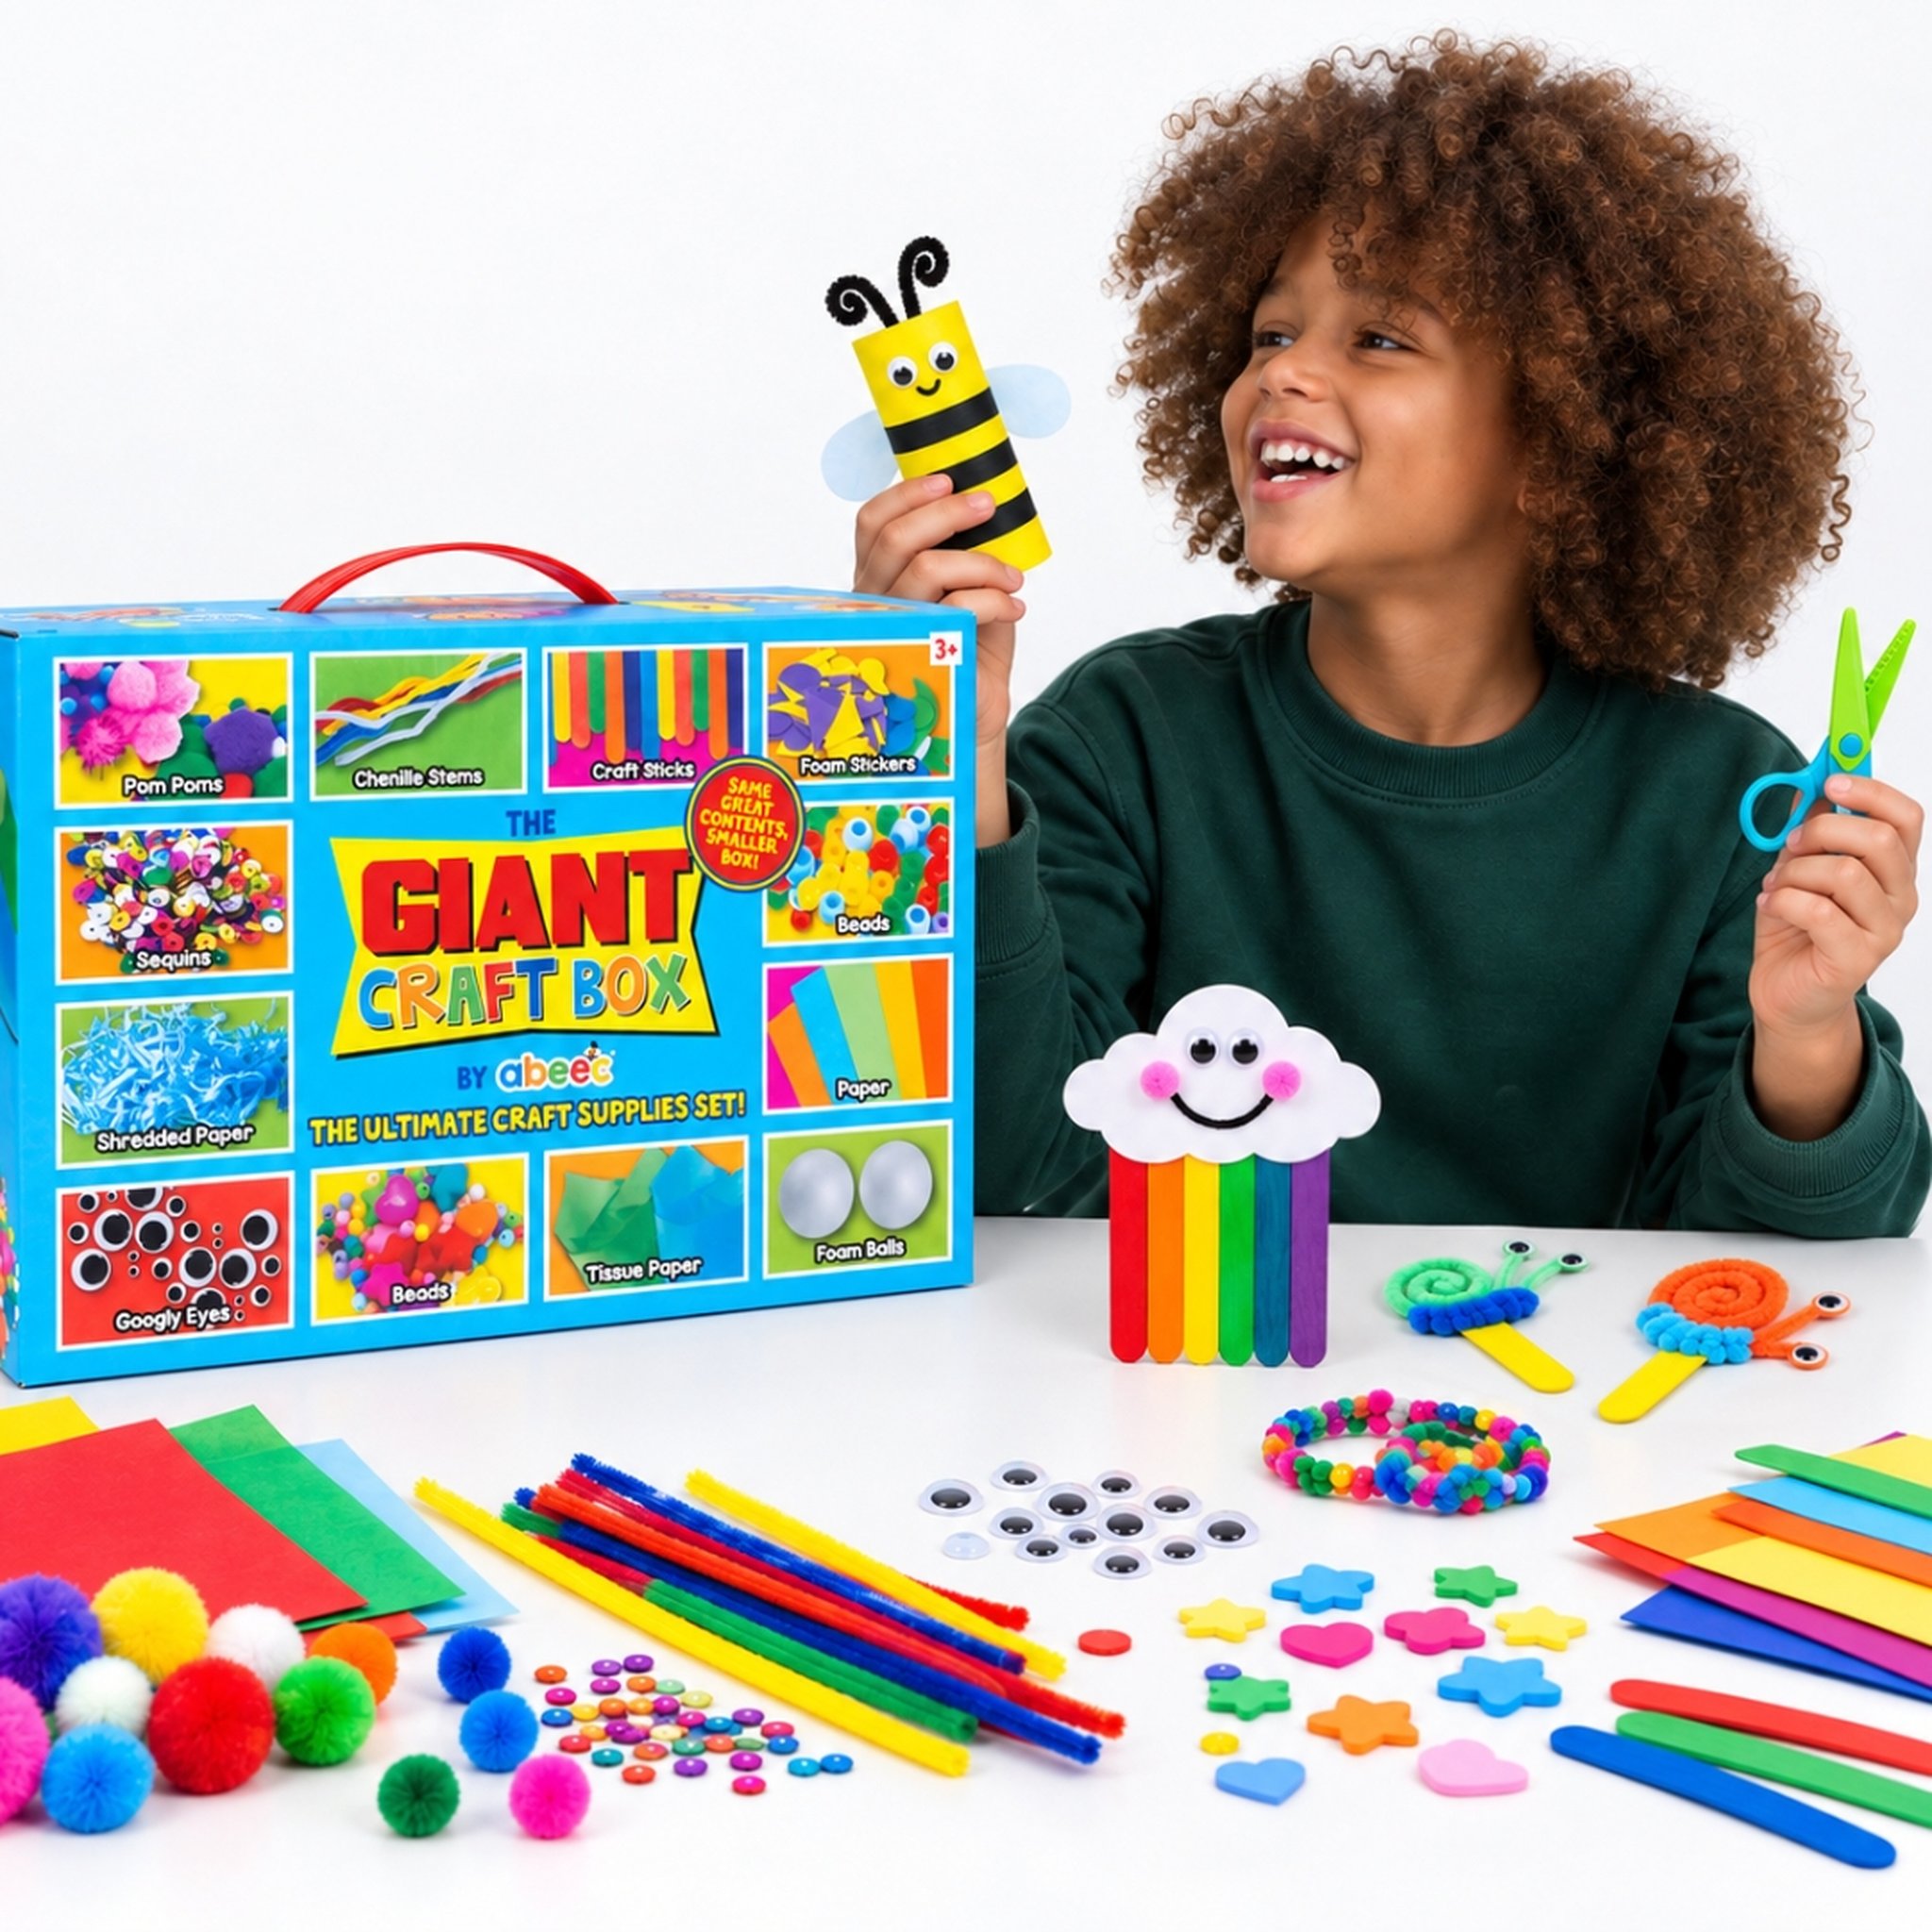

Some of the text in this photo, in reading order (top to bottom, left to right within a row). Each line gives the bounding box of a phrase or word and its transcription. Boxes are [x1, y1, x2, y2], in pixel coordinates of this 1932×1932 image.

[935, 638, 958, 659] 3+
[592, 759, 694, 779] Craft Sticks
[801, 756, 916, 774] Foam Stickers
[124, 775, 223, 796] Pom Poms
[354, 768, 483, 788] Chenille Stems
[728, 778, 772, 799] SAME
[721, 796, 774, 814] GREAT
[507, 809, 556, 835] THE
[700, 808, 789, 840] CONTENTS,
[705, 830, 778, 855] SMALLER
[721, 850, 758, 869] BOX!
[362, 847, 693, 956] GIANT
[838, 915, 890, 934] Beads
[137, 950, 211, 972] Sequins
[358, 953, 691, 1028] CRAFT BOX
[457, 1052, 613, 1091] BY abeec
[838, 1079, 890, 1099] Paper
[310, 1091, 745, 1144] THE ULTIMATE CRAFT SUPPLIES SET!
[97, 1123, 254, 1152] Shredded Paper
[817, 1238, 904, 1262] Foam Balls
[586, 1257, 702, 1284] Tissue Paper
[392, 1284, 449, 1304] Beads
[115, 1305, 231, 1334] Googly Eyes
